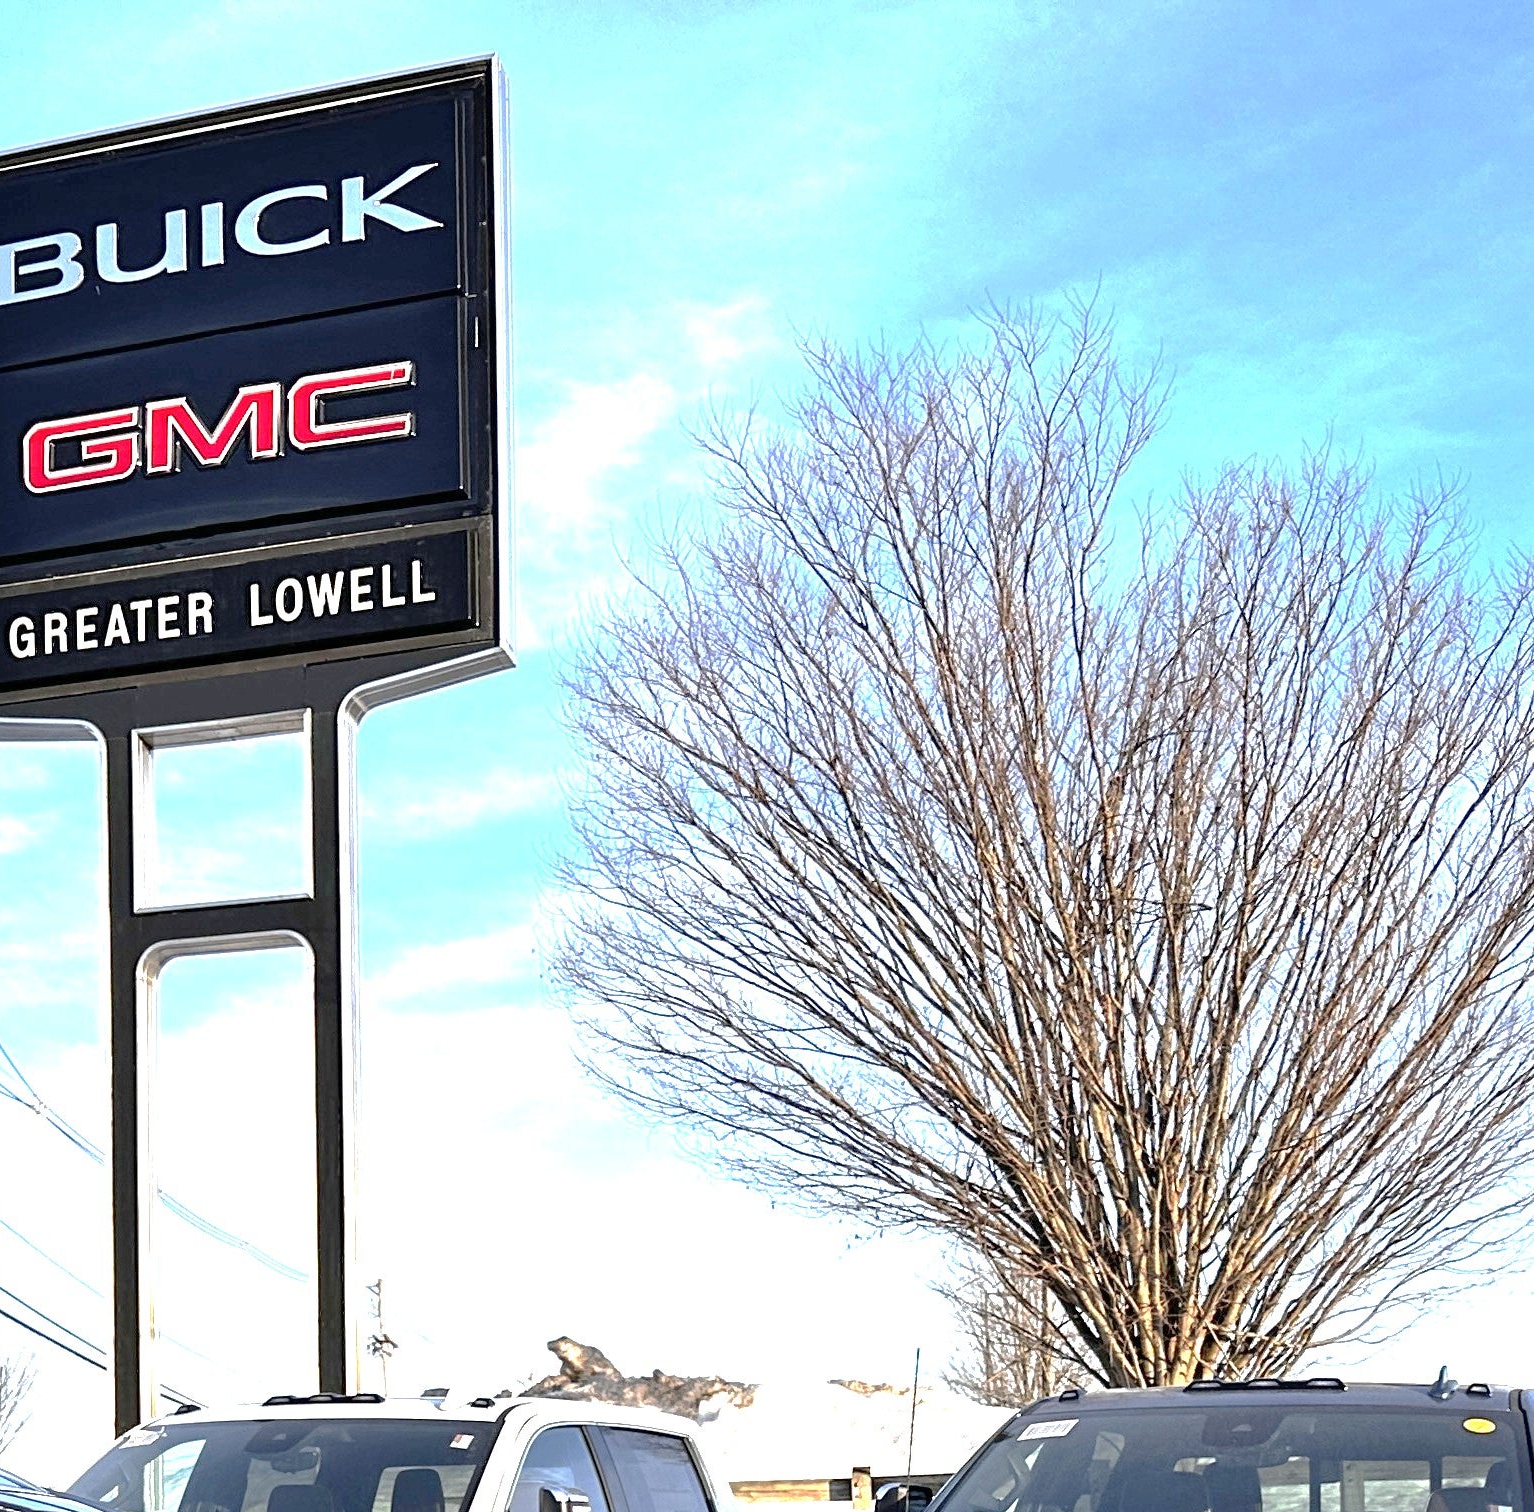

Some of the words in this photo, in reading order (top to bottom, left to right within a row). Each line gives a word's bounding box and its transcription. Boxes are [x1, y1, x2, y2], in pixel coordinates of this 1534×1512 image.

[22, 361, 417, 495] GMC
[8, 591, 214, 660] GREATER
[250, 559, 436, 627] LOWELL
